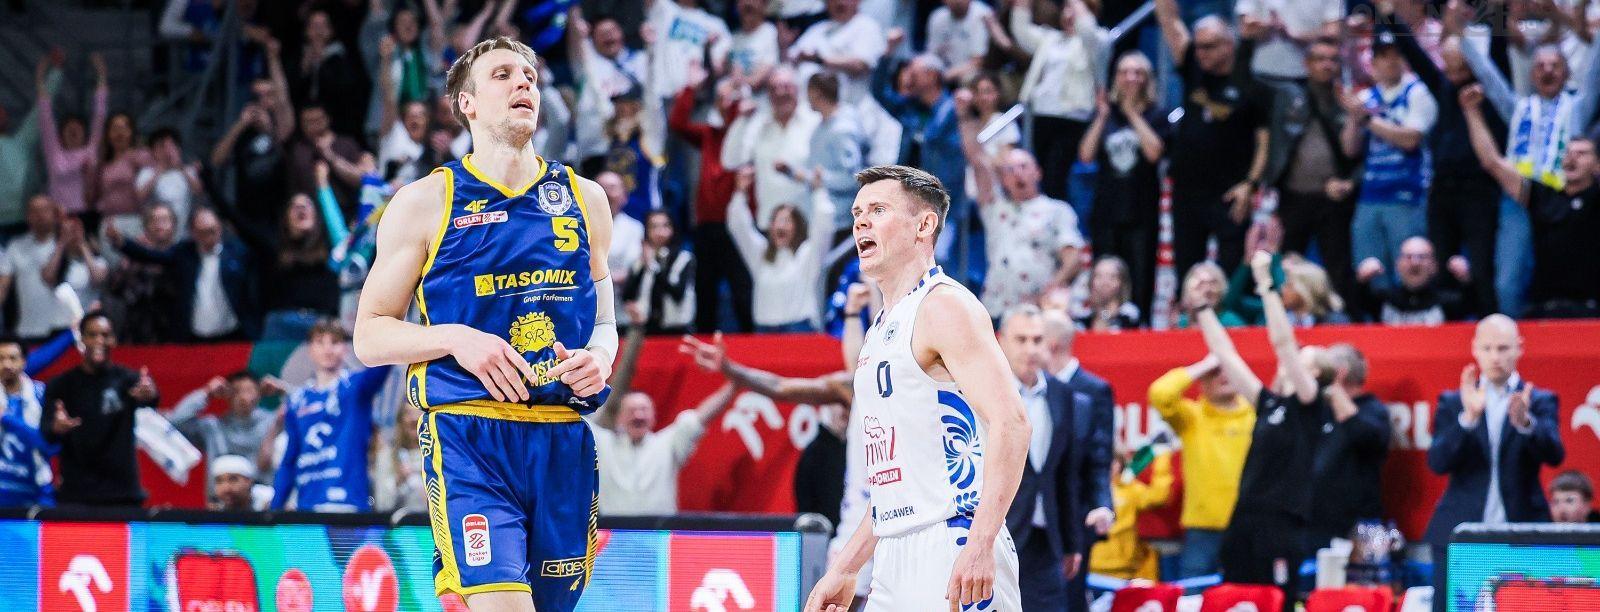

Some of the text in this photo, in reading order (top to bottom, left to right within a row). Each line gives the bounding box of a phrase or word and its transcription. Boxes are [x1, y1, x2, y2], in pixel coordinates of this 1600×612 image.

[464, 199, 488, 213] 4F
[456, 215, 483, 226] ORLEN
[552, 217, 579, 251] 5
[495, 270, 576, 290] TASOMIX
[523, 295, 541, 303] Grupa
[876, 360, 893, 398] 0
